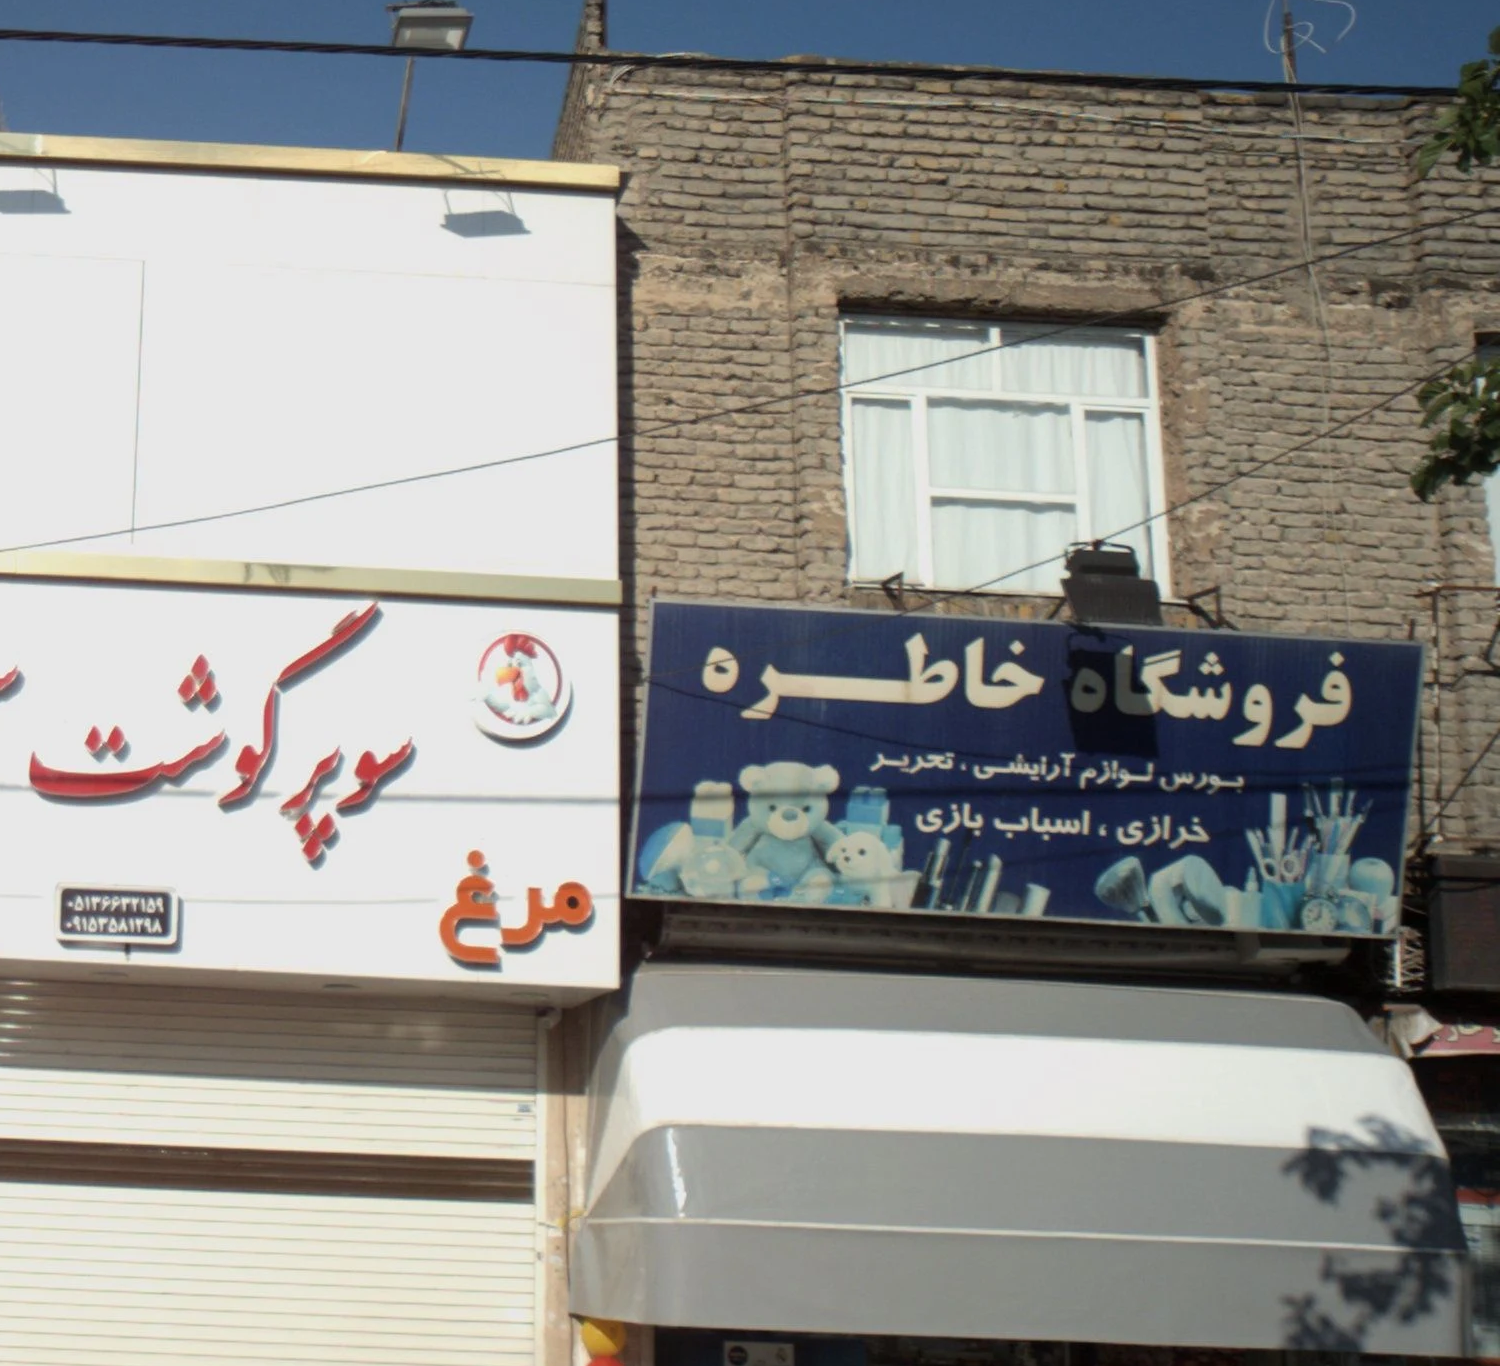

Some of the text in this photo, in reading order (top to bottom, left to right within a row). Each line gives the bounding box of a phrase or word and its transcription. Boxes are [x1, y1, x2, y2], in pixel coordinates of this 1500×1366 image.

[29, 601, 379, 807] گوشت
[1071, 645, 1352, 749] فروشگاه
[280, 736, 414, 862] سوپر
[1079, 760, 1154, 789] لوازم
[915, 803, 985, 835] بازی
[993, 807, 1091, 841] اسباب
[1116, 815, 1211, 849] خرازی
[438, 848, 594, 965] مرغ
